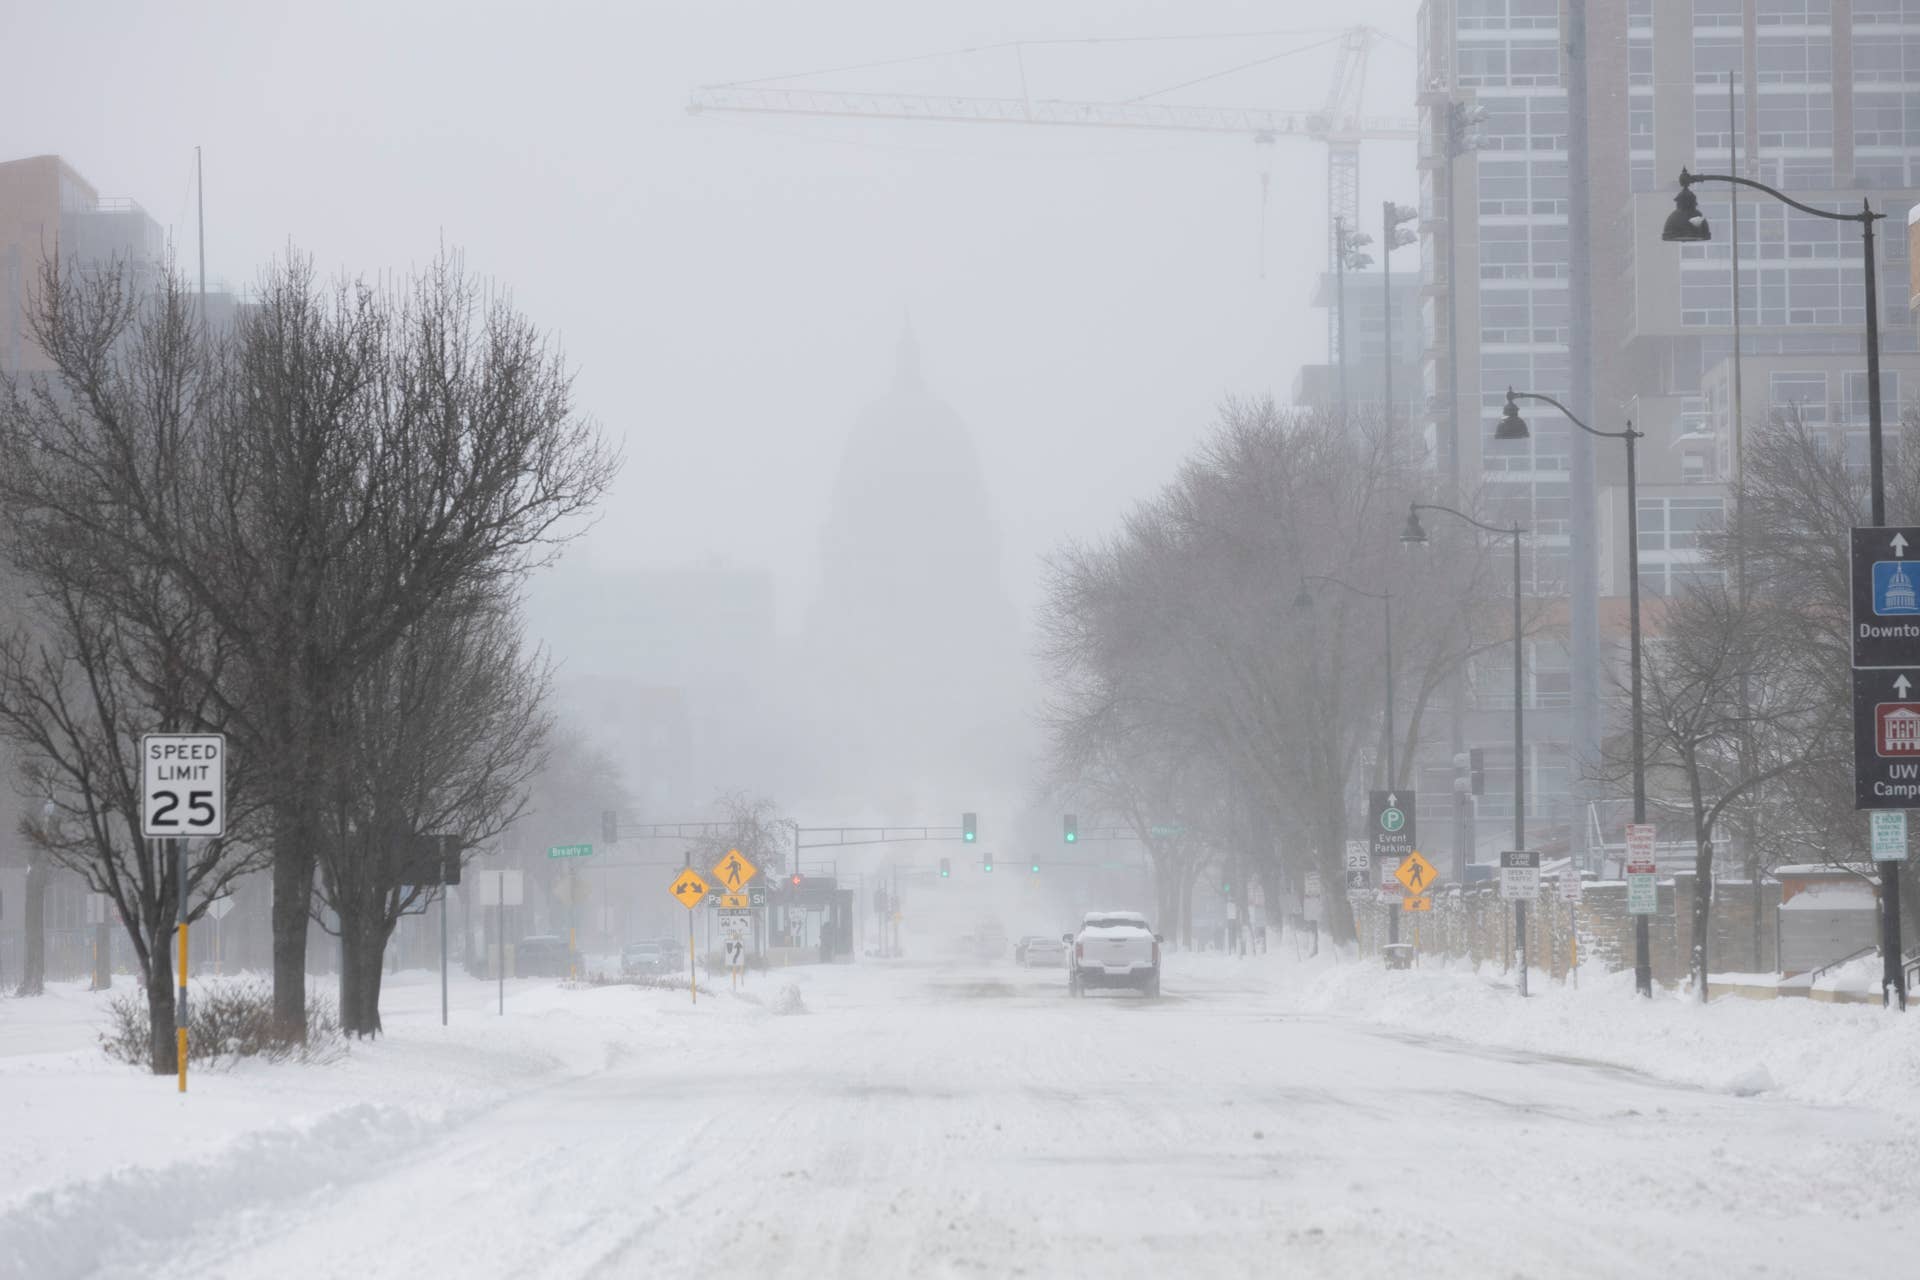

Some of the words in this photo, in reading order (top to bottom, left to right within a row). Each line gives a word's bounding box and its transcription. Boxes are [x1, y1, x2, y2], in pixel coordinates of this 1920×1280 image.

[1860, 623, 1920, 638] Downto
[150, 744, 217, 760] SPEED
[157, 765, 209, 781] LIMIT
[1889, 764, 1918, 779] UW
[1873, 781, 1920, 799] Camp
[150, 790, 216, 827] 25
[1387, 812, 1399, 828] P
[1882, 815, 1902, 824] HOUR
[1379, 834, 1407, 843] Event
[1375, 843, 1412, 853] Parking
[1348, 855, 1368, 868] 25
[753, 895, 764, 904] St
